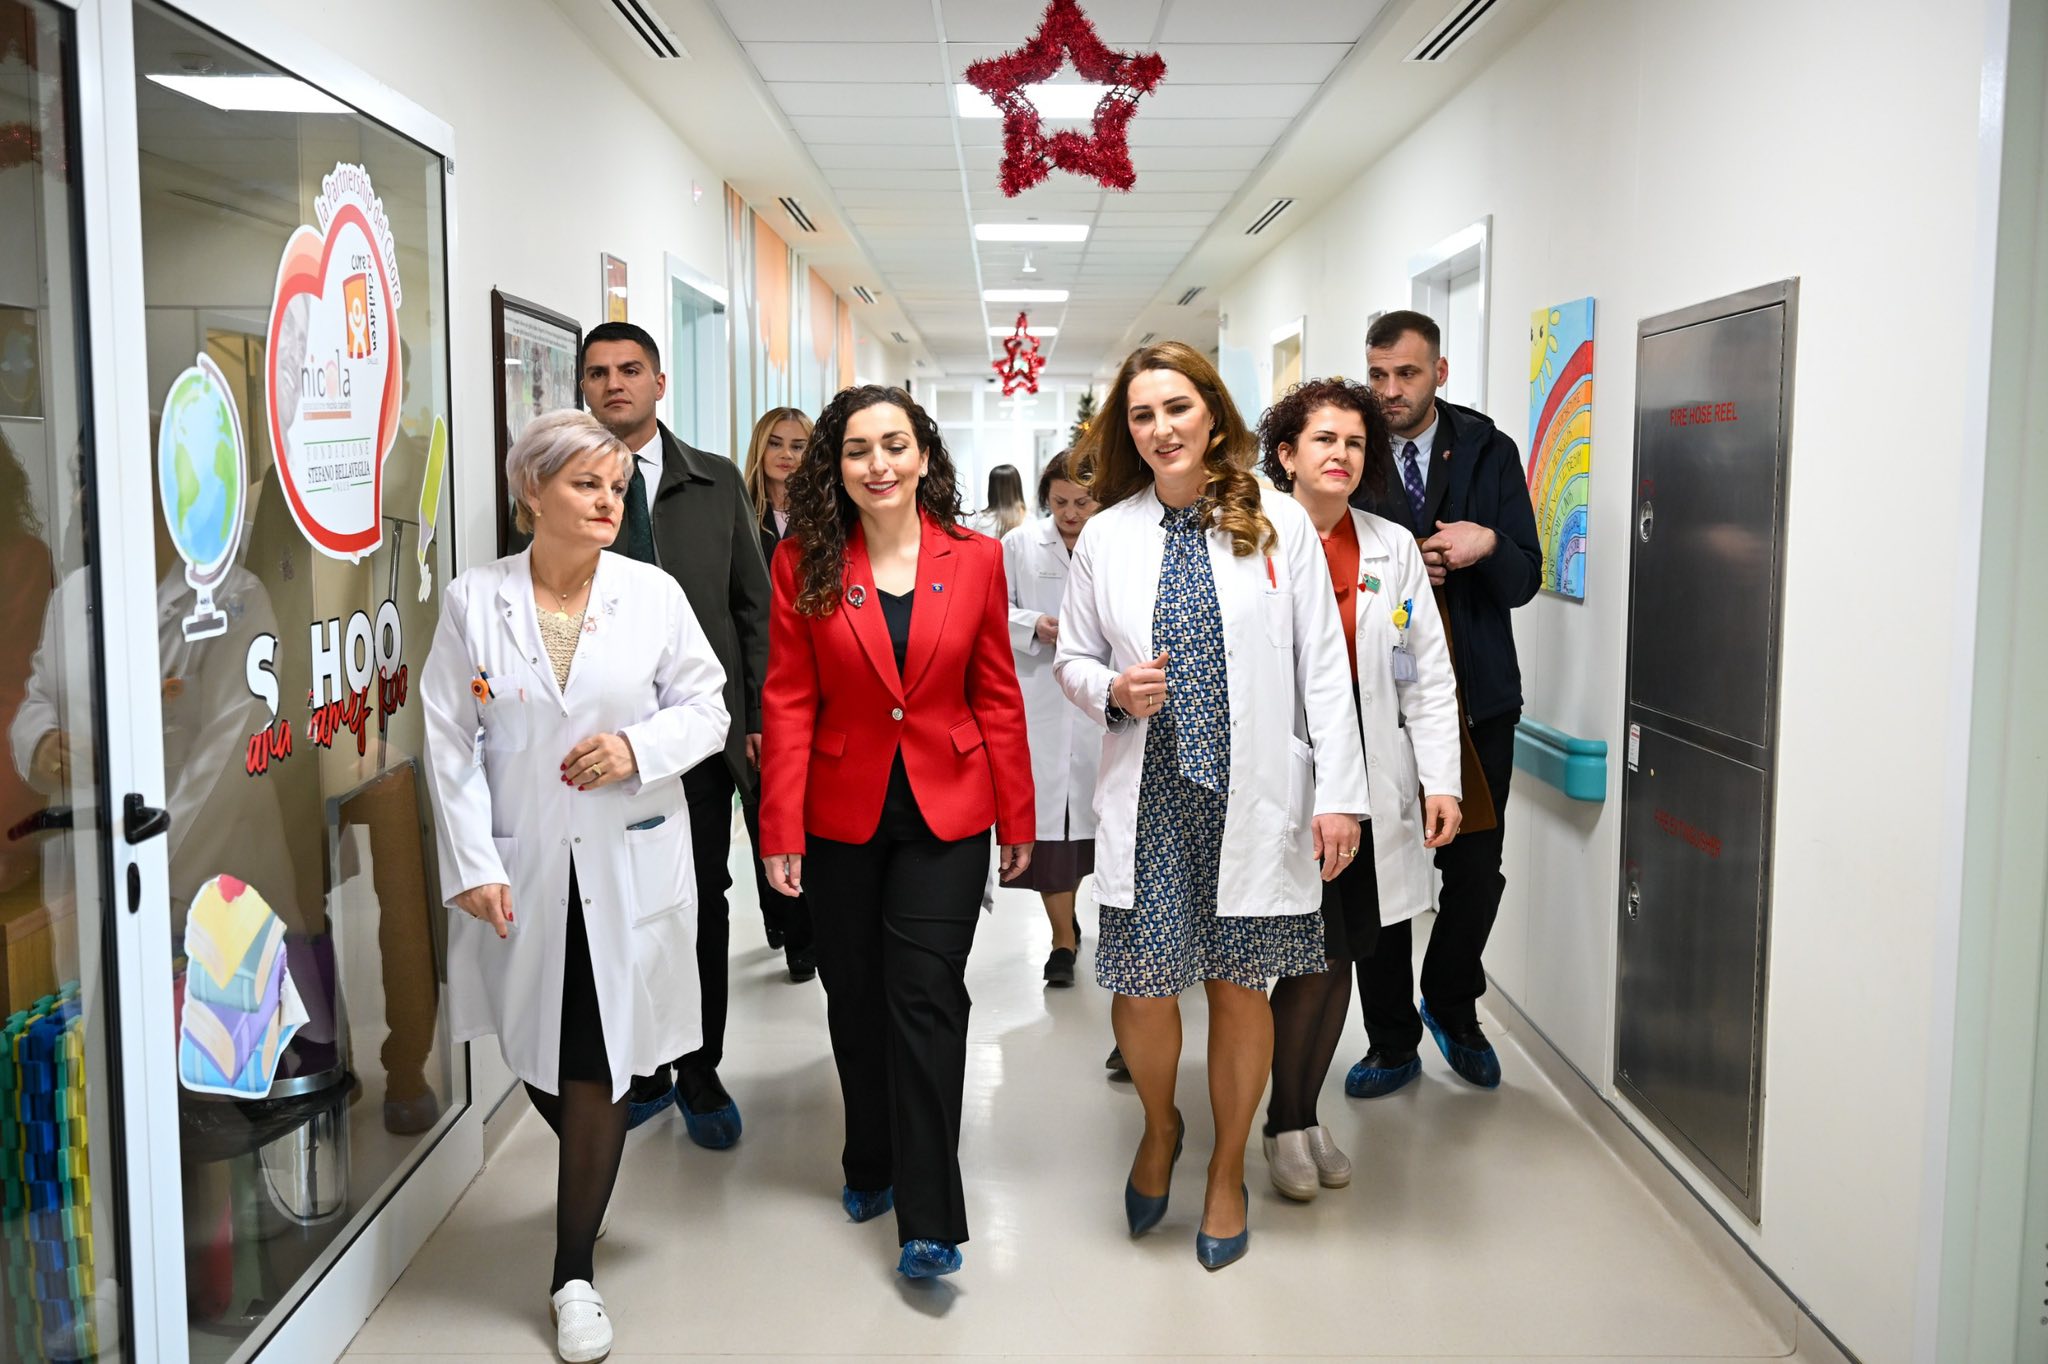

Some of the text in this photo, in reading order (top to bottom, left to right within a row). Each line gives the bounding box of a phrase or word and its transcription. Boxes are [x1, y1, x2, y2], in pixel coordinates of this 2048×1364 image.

[316, 168, 401, 304] la Partnership del Cuore
[300, 348, 351, 400] nicola
[1669, 401, 1738, 427] FIRE HOSE REEL
[308, 465, 335, 484] STEFANO
